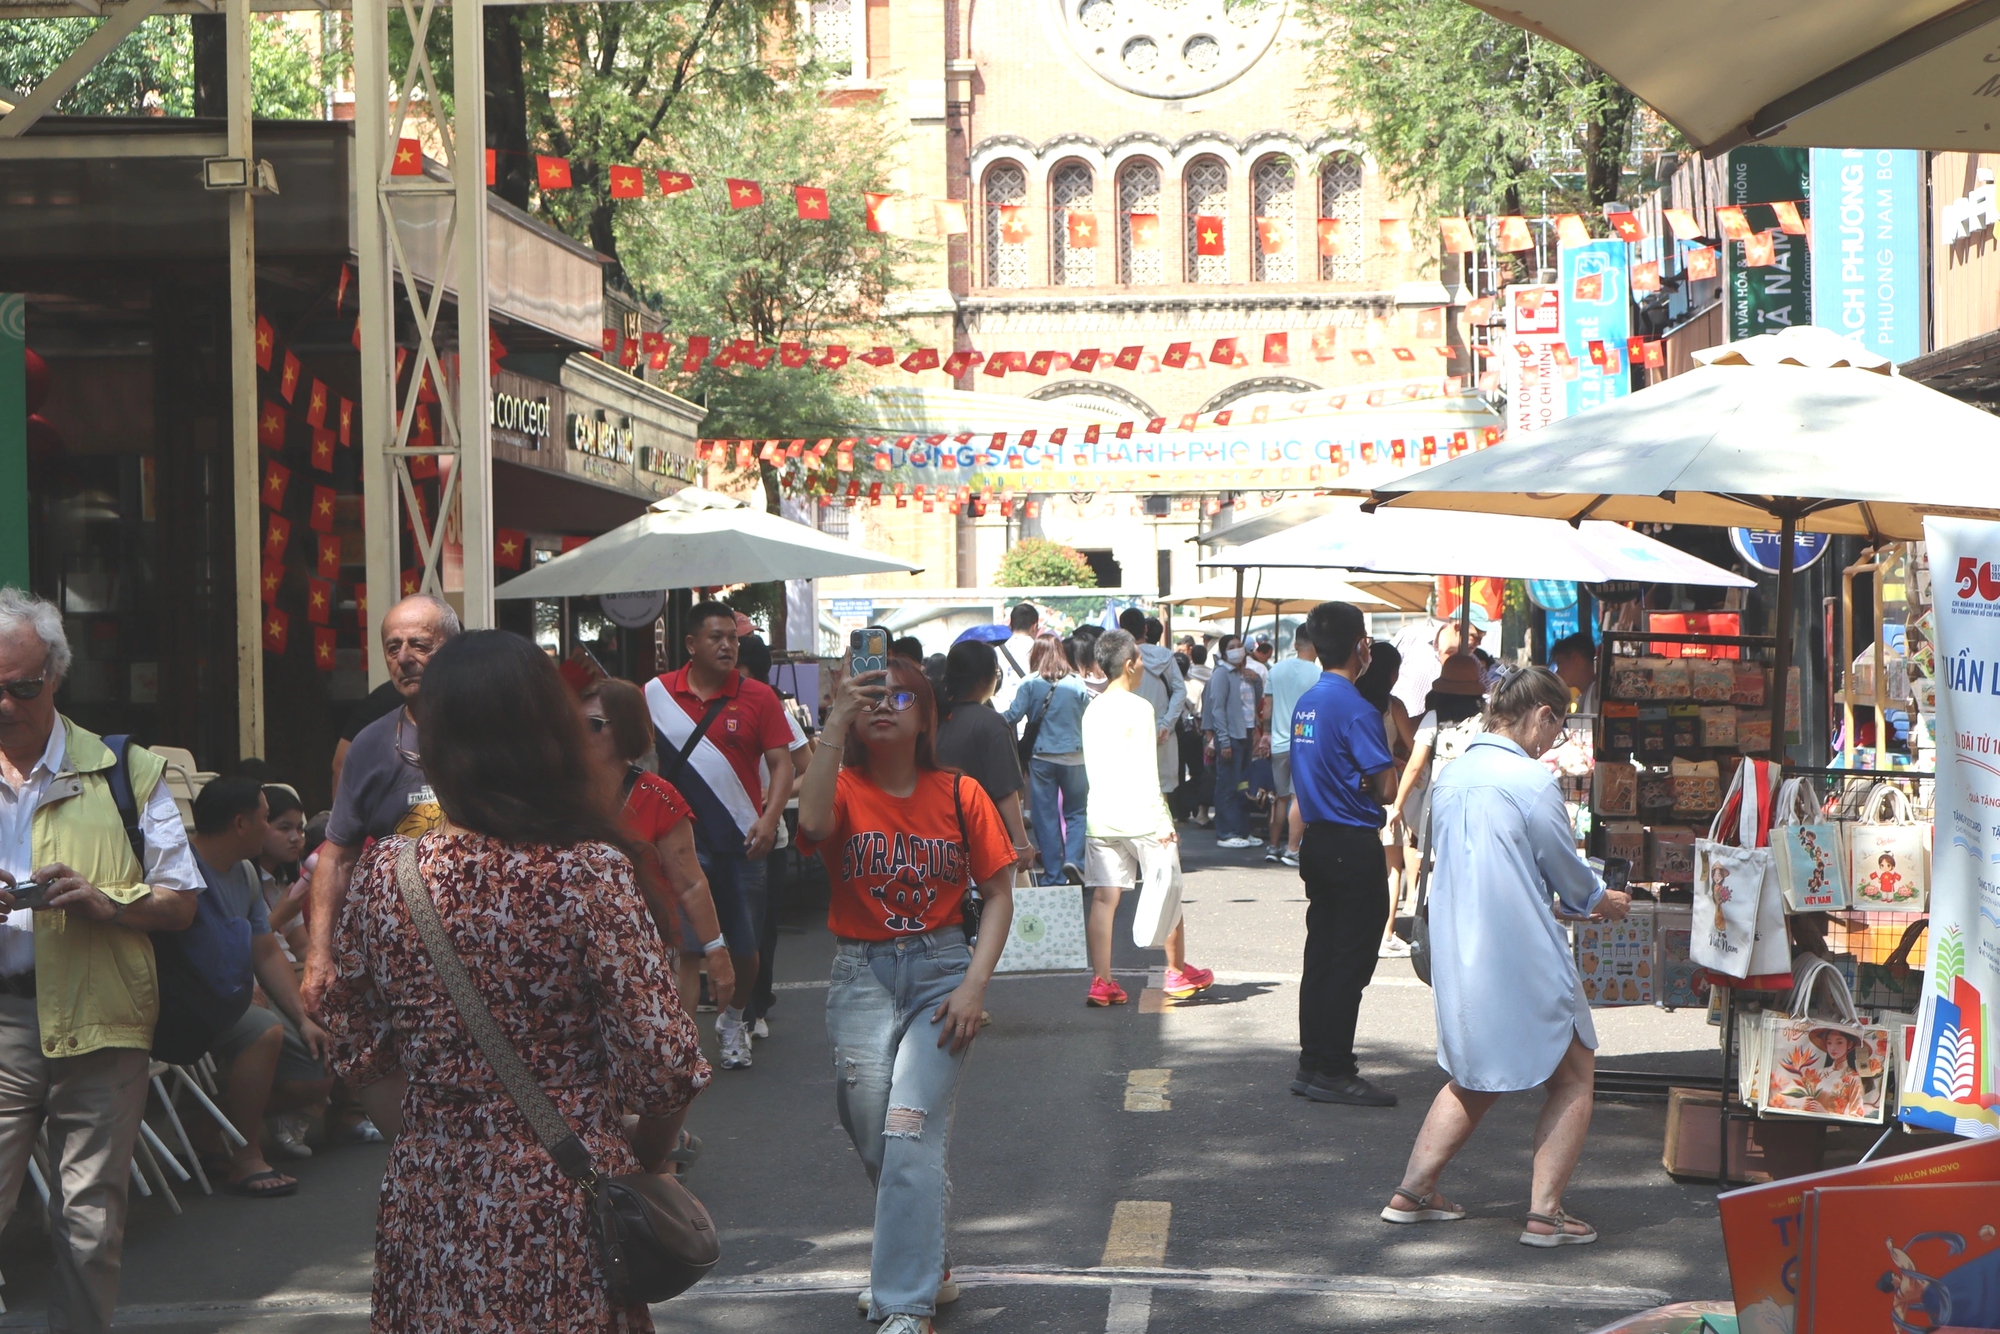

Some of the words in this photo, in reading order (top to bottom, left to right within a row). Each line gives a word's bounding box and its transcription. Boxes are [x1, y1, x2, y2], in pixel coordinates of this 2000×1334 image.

[1876, 149, 1893, 180] BO
[1734, 162, 1747, 206] THÔNG
[1839, 165, 1866, 282] PHƯƠNG
[1876, 189, 1894, 240] NAM
[1736, 260, 1747, 269] &
[1734, 270, 1748, 298] HÓA
[1876, 248, 1895, 345] PHUONG
[1735, 300, 1748, 328] VĂN
[1539, 343, 1552, 378] MINH
[496, 391, 551, 438] concept
[1977, 732, 1991, 754] TỪ
[1817, 895, 1832, 905] NAM
[1893, 1169, 1928, 1184] AVALON
[1928, 1162, 1960, 1176] NUOVO
[1787, 1195, 1803, 1205] IRIS
